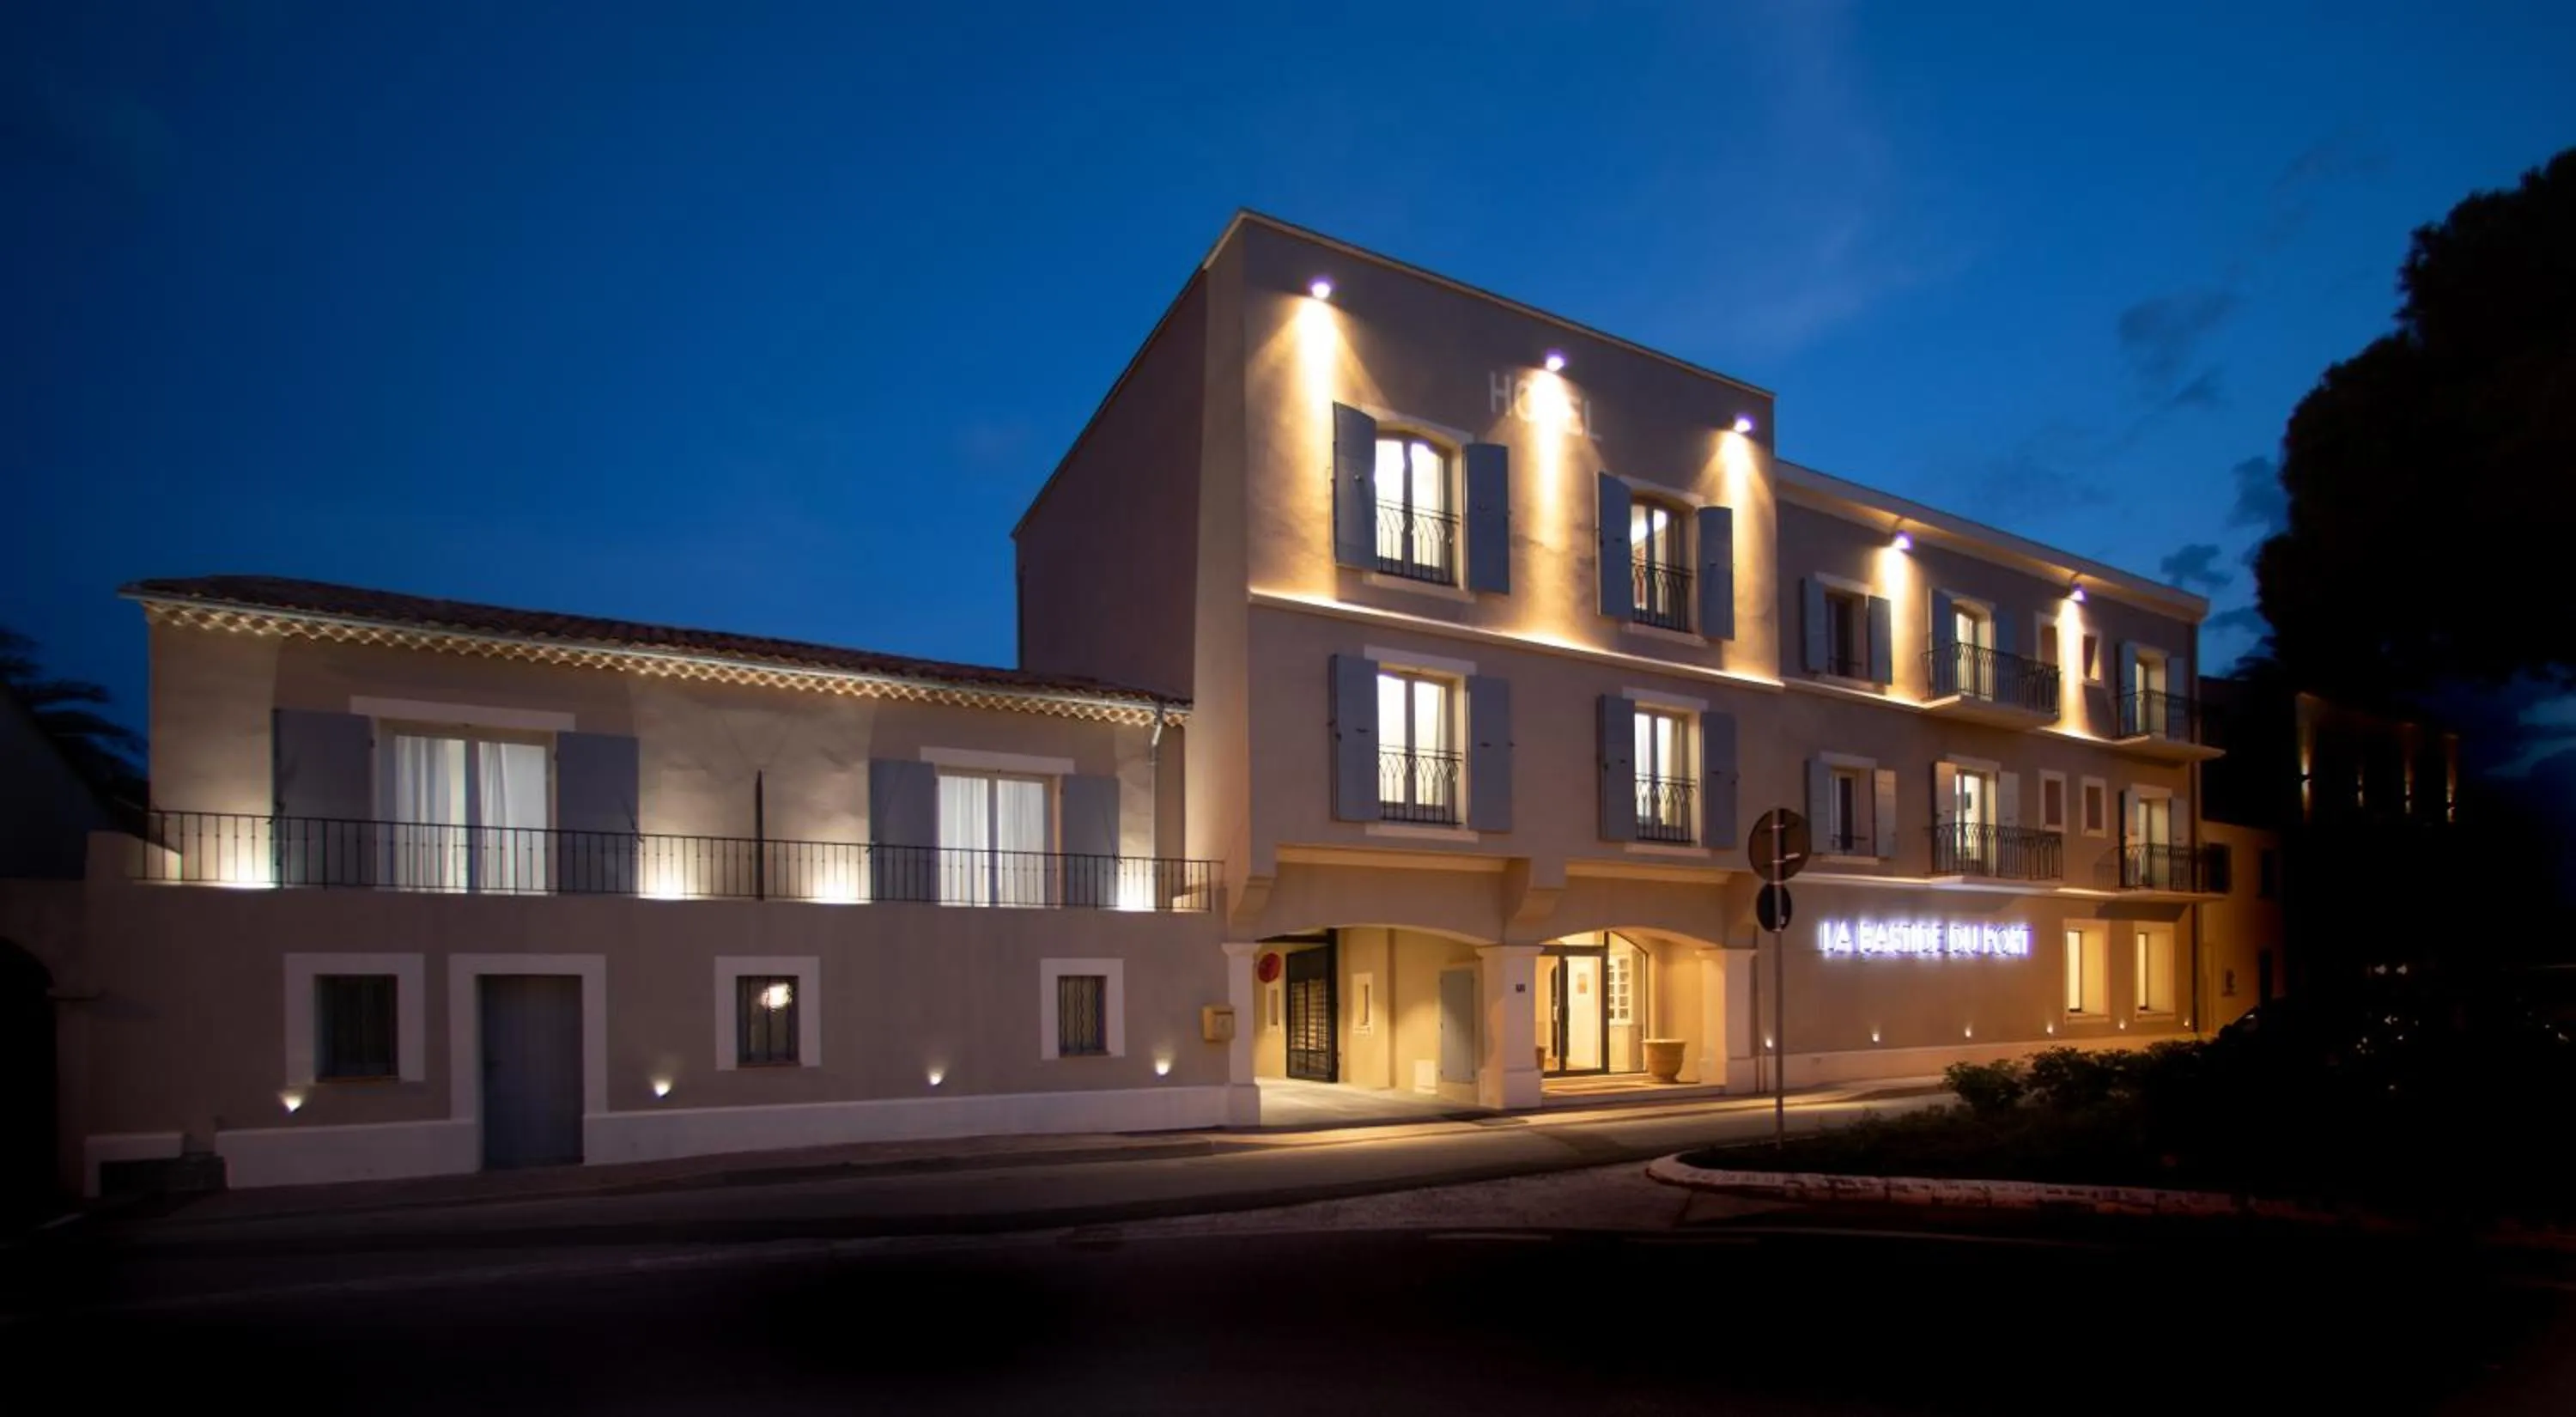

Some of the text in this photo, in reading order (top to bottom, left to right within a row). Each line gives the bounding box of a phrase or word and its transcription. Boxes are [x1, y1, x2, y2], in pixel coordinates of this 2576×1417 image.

[1489, 371, 1603, 442] HOEL
[1819, 920, 2032, 956] LA BASTIDE DU PORT
